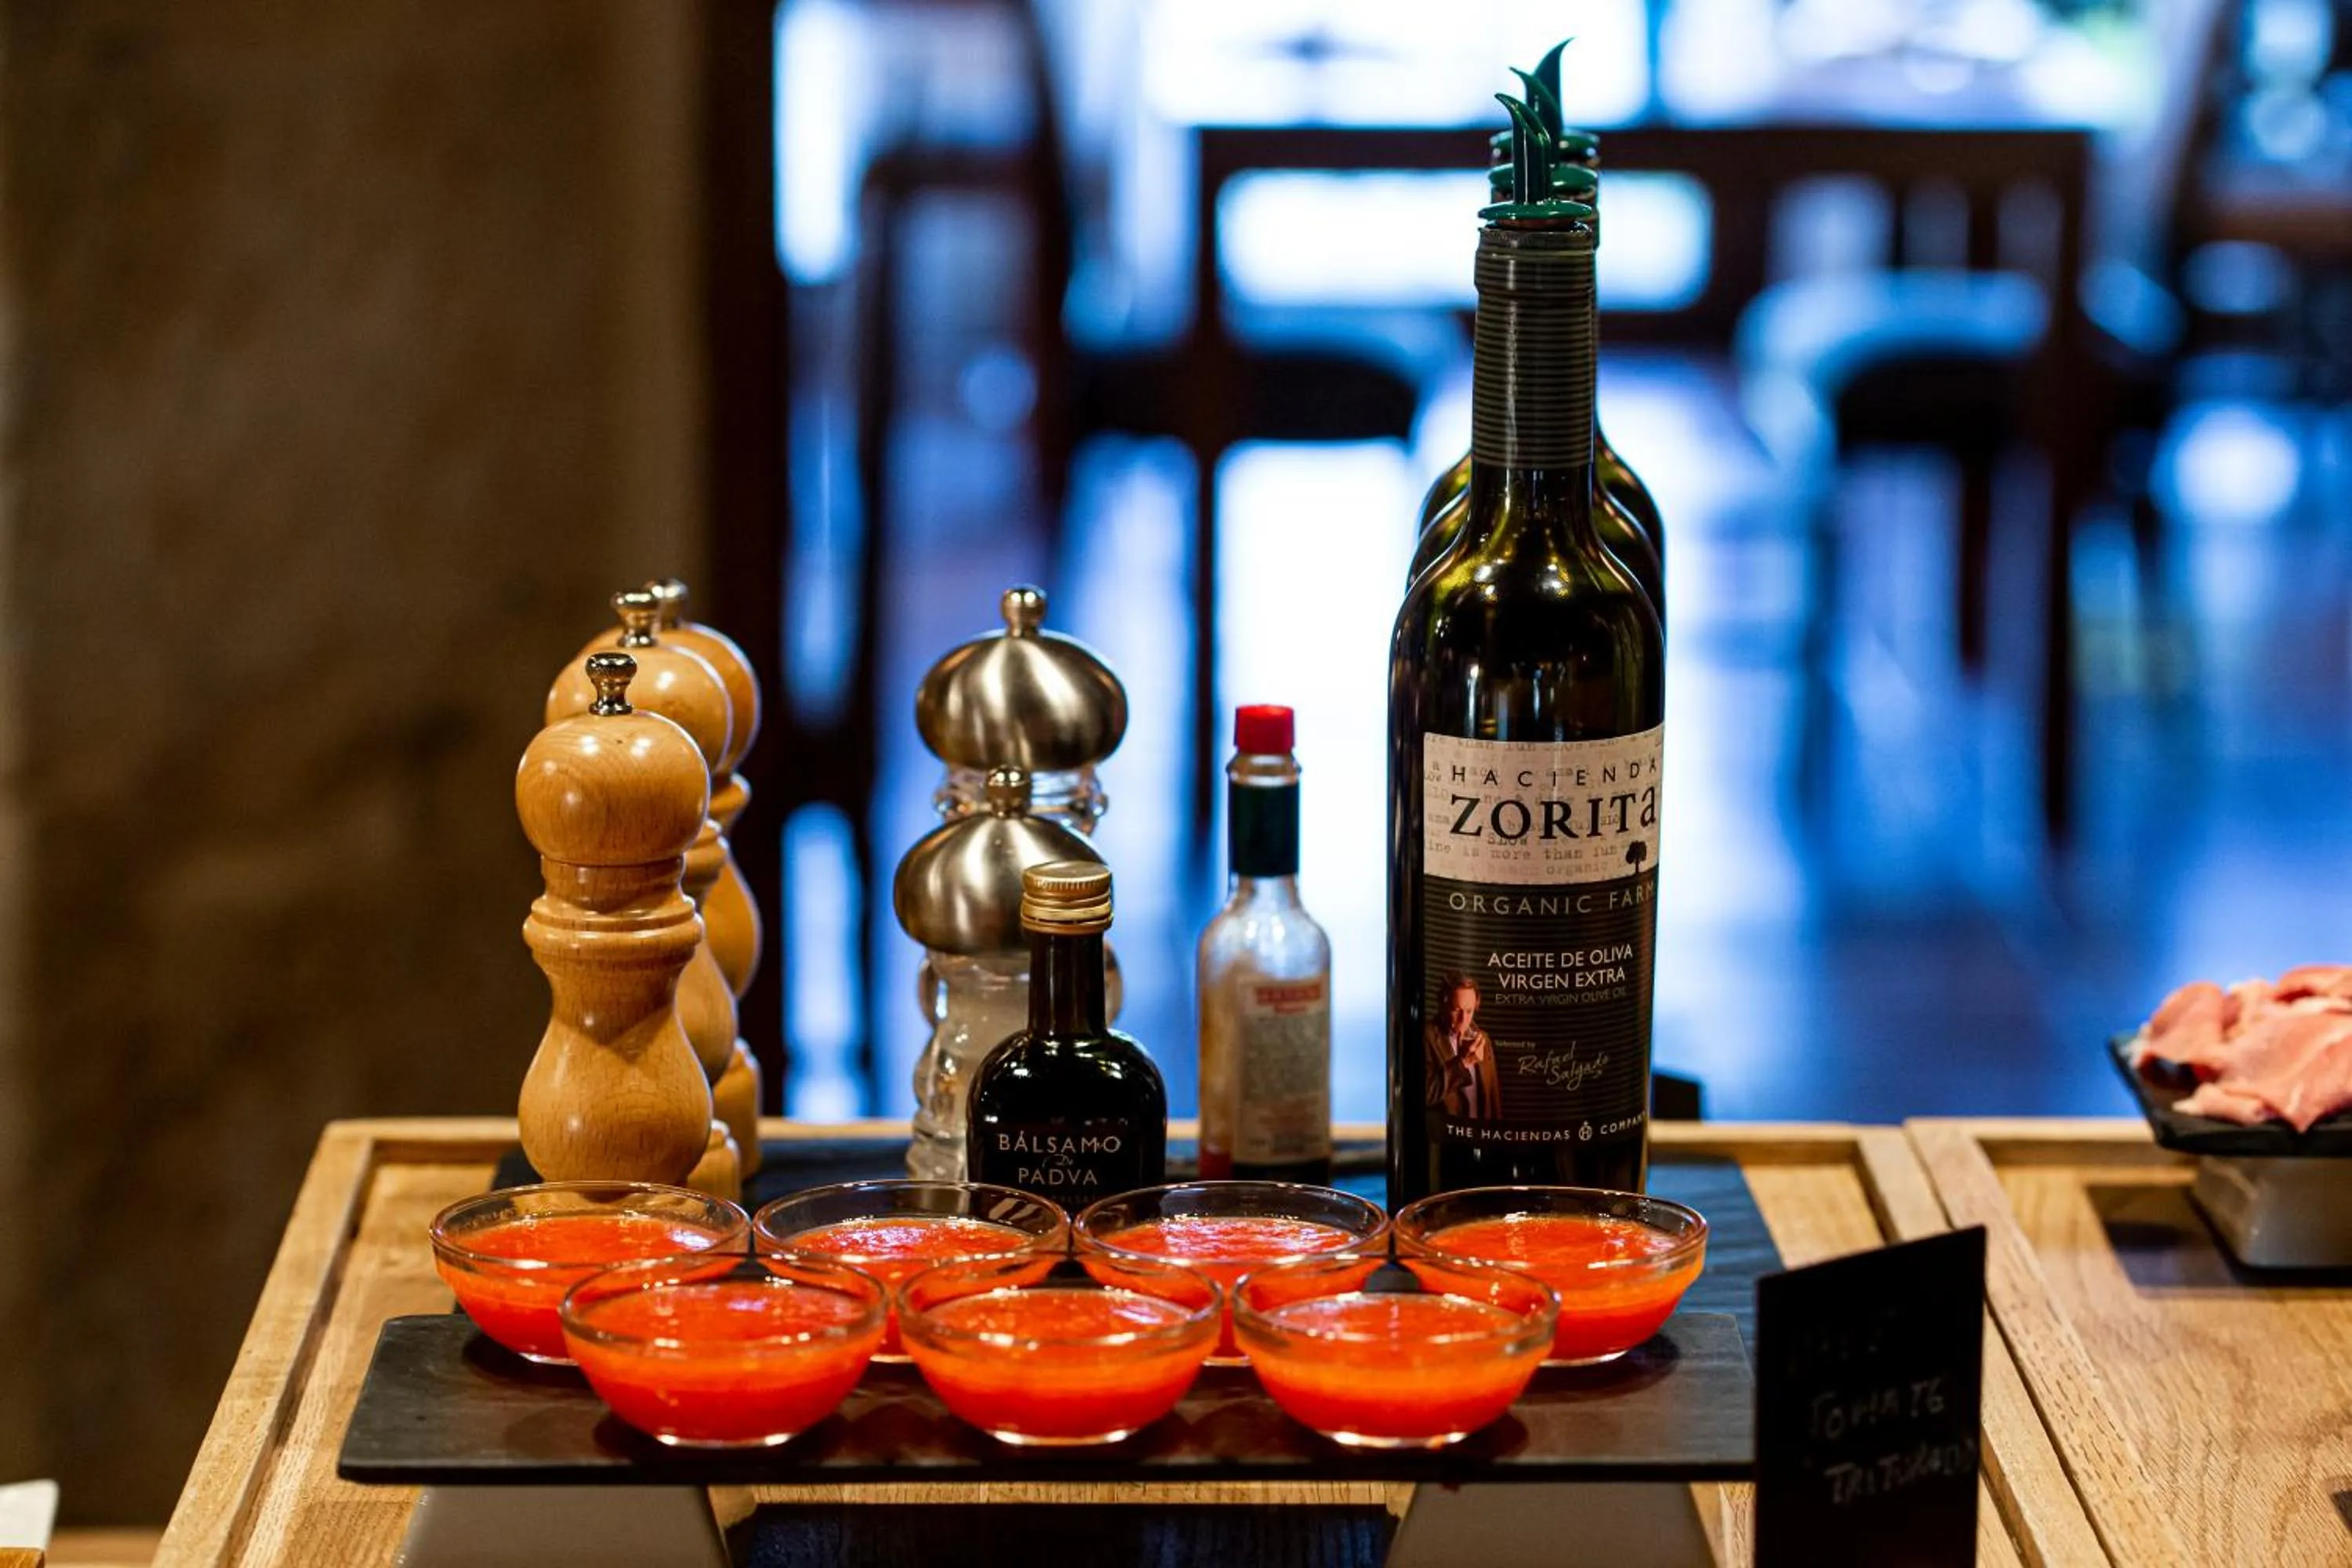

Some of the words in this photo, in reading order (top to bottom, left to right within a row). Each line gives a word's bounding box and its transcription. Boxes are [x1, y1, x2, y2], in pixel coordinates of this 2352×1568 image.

[1452, 756, 1657, 787] HACIENDA
[1490, 849, 1531, 860] more
[1544, 848, 1583, 860] than
[1449, 891, 1592, 915] ORGANIC
[1488, 952, 1555, 969] ACEITE
[1561, 951, 1584, 967] DE
[1589, 943, 1634, 965] OLIVA
[1498, 973, 1569, 990] VIRGEN
[1575, 967, 1626, 988] EXTRA
[1495, 993, 1537, 1005] EXTRA
[1538, 993, 1579, 1005] VIRGIN
[998, 1130, 1122, 1154] BÁLSAMO
[1446, 1124, 1474, 1138] THE
[1481, 1129, 1571, 1142] HACIENDAS
[1018, 1167, 1098, 1186] PADVA
